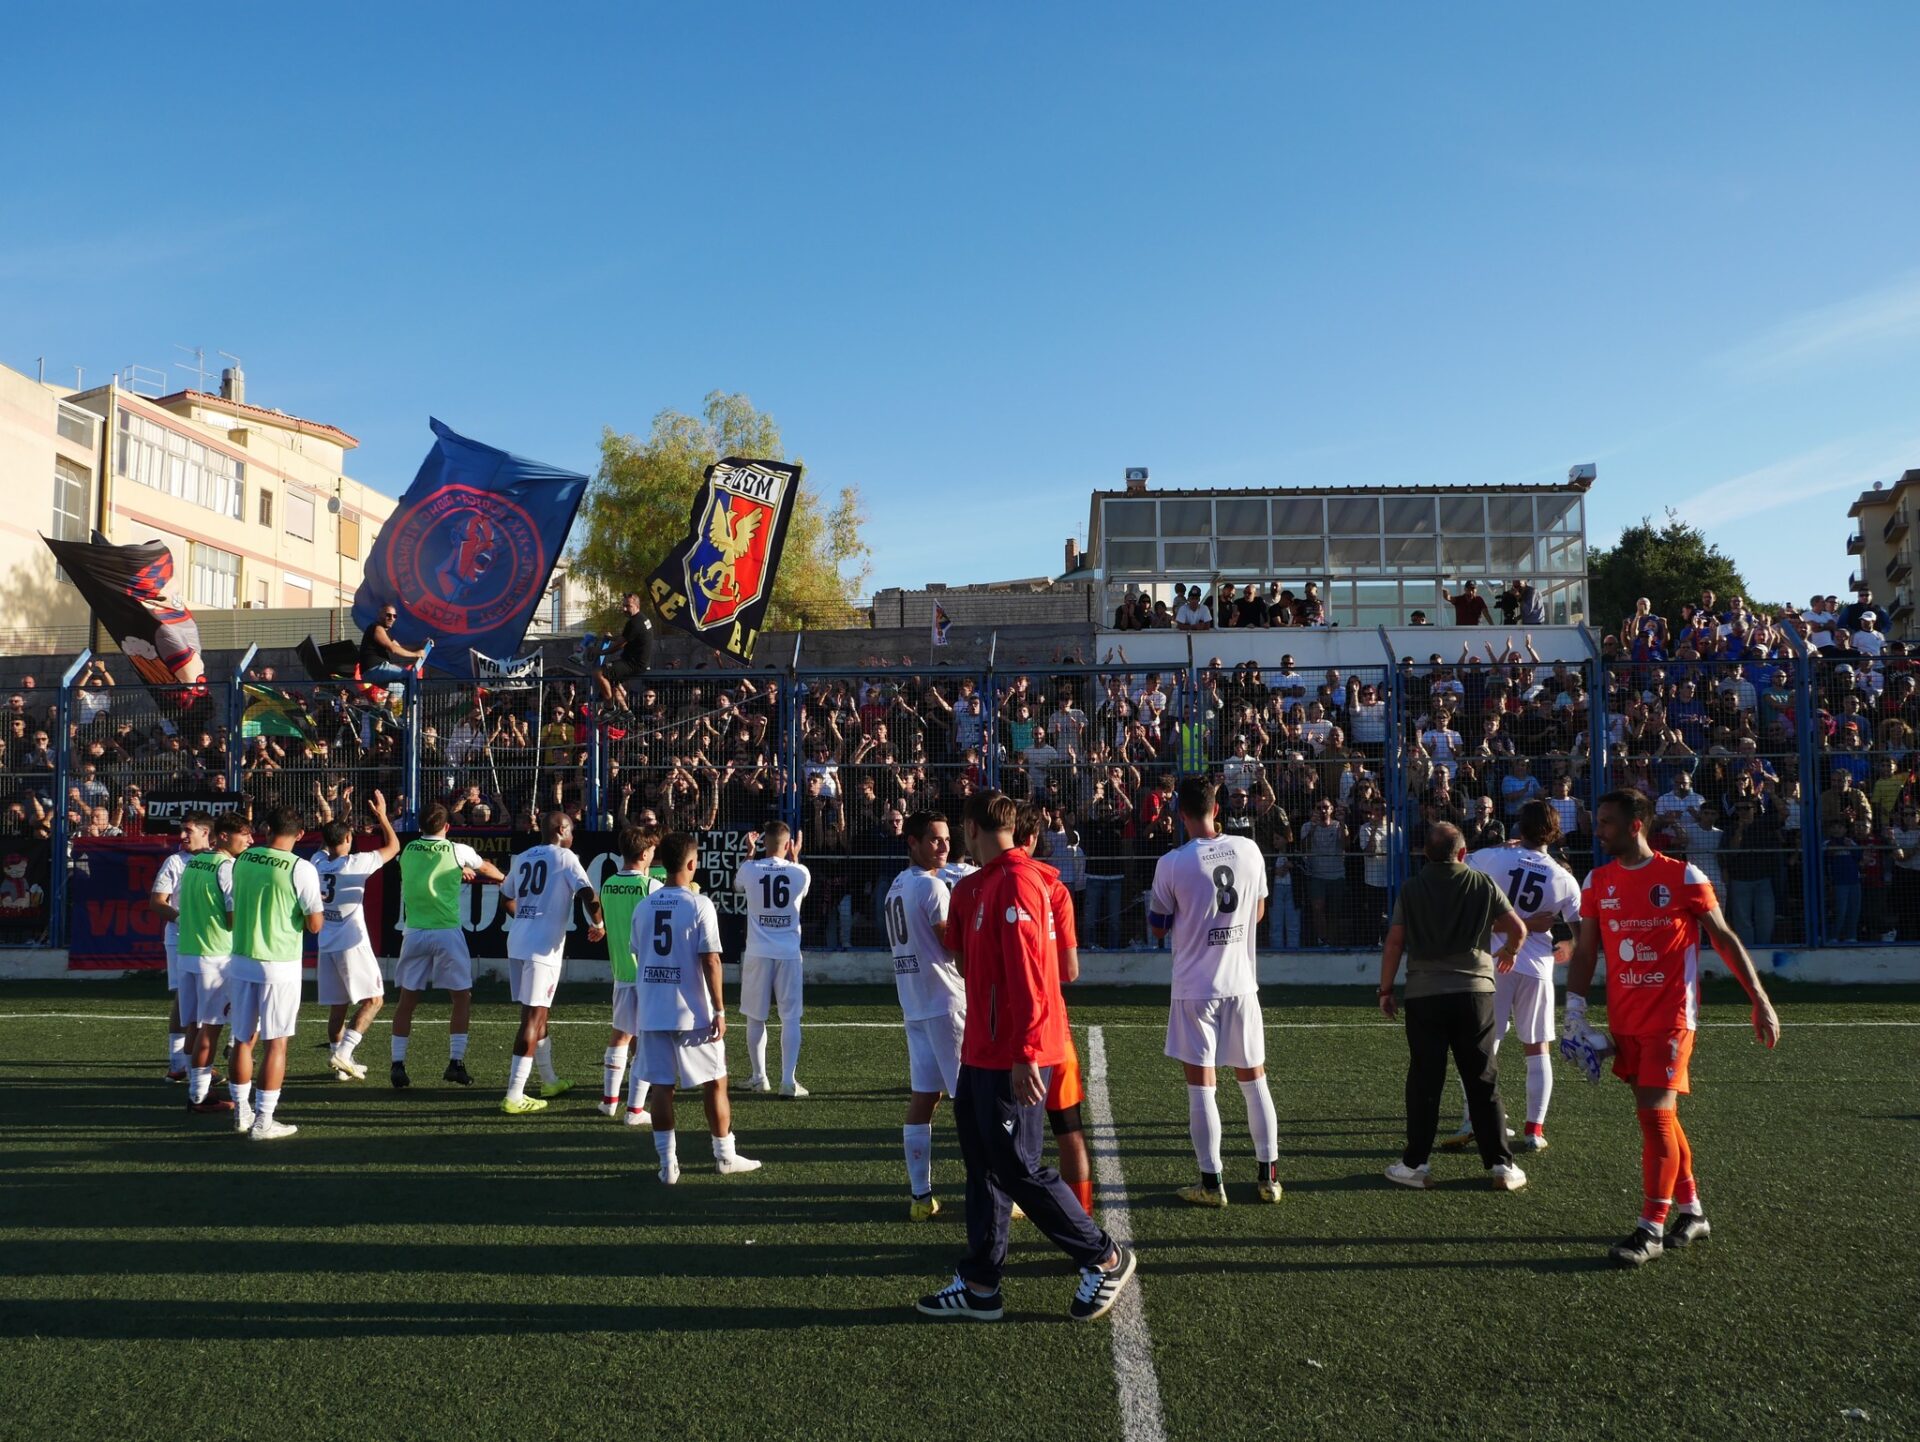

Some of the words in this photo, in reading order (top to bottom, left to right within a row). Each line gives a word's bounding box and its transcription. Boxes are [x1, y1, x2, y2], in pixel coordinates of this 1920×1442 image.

[479, 656, 500, 674] MAI
[240, 851, 290, 871] macron
[406, 843, 450, 854] macron
[320, 873, 337, 904] 3
[518, 860, 547, 897] 20
[603, 884, 643, 895] macron
[710, 870, 730, 888] DI
[758, 874, 791, 909] 16
[1213, 865, 1239, 914] 8
[1508, 867, 1548, 913] 15
[653, 910, 673, 957] 5
[885, 895, 908, 947] 10
[643, 967, 682, 980] FRANZY'S
